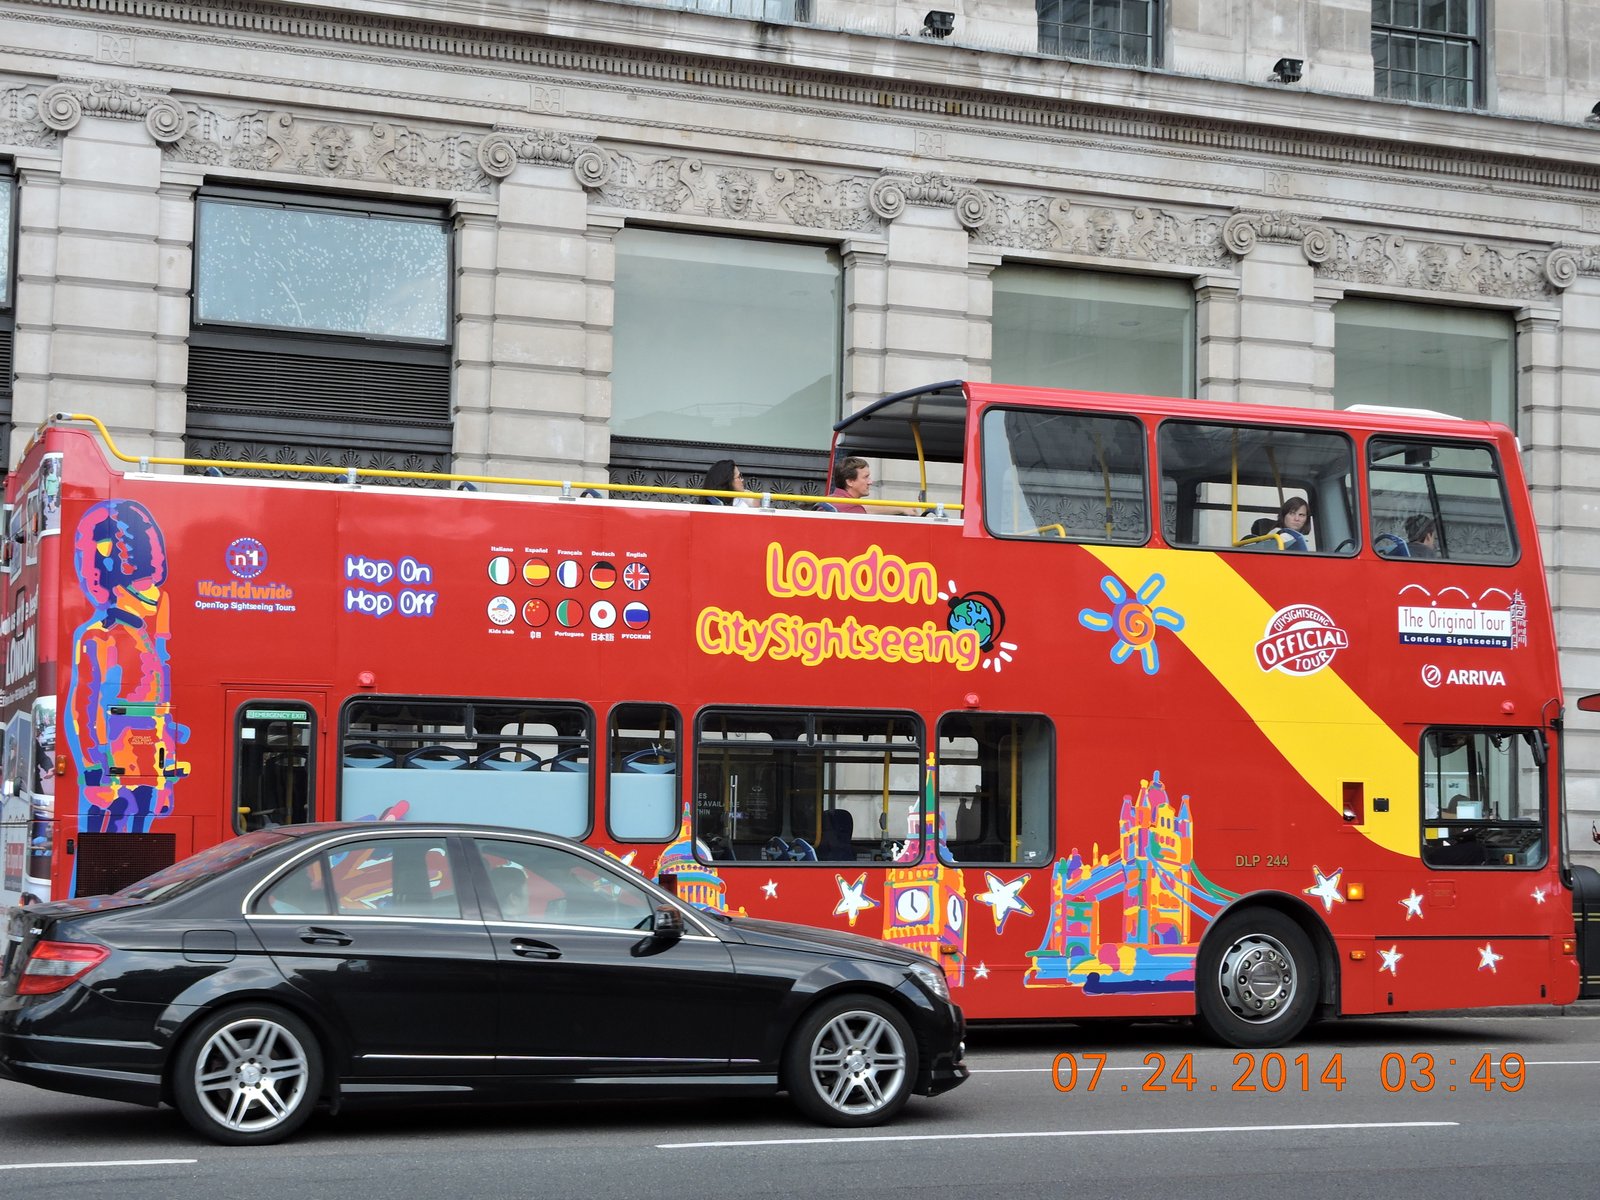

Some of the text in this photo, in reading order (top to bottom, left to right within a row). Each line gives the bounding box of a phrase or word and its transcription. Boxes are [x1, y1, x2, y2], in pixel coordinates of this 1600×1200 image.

[524, 546, 549, 554] Español
[346, 557, 430, 584] Hop On
[766, 542, 938, 605] London
[197, 580, 293, 599] Worldwide
[195, 600, 296, 612] OpenTop Sightseeing Tours
[346, 589, 436, 615] Hop Off
[1273, 608, 1330, 632] CITYSIGHTSEEING
[1403, 608, 1505, 634] The Original Tour
[696, 606, 980, 672] CitySightseeing
[1262, 630, 1347, 665] OFFICIAL
[1404, 635, 1508, 647] London Sightseeing
[5, 623, 36, 687] LONDON
[1295, 650, 1330, 671] TOUR
[1446, 669, 1506, 686] ARRIVA
[255, 711, 306, 720] EMERGENCY EXIT
[1235, 855, 1289, 867] DLP 244
